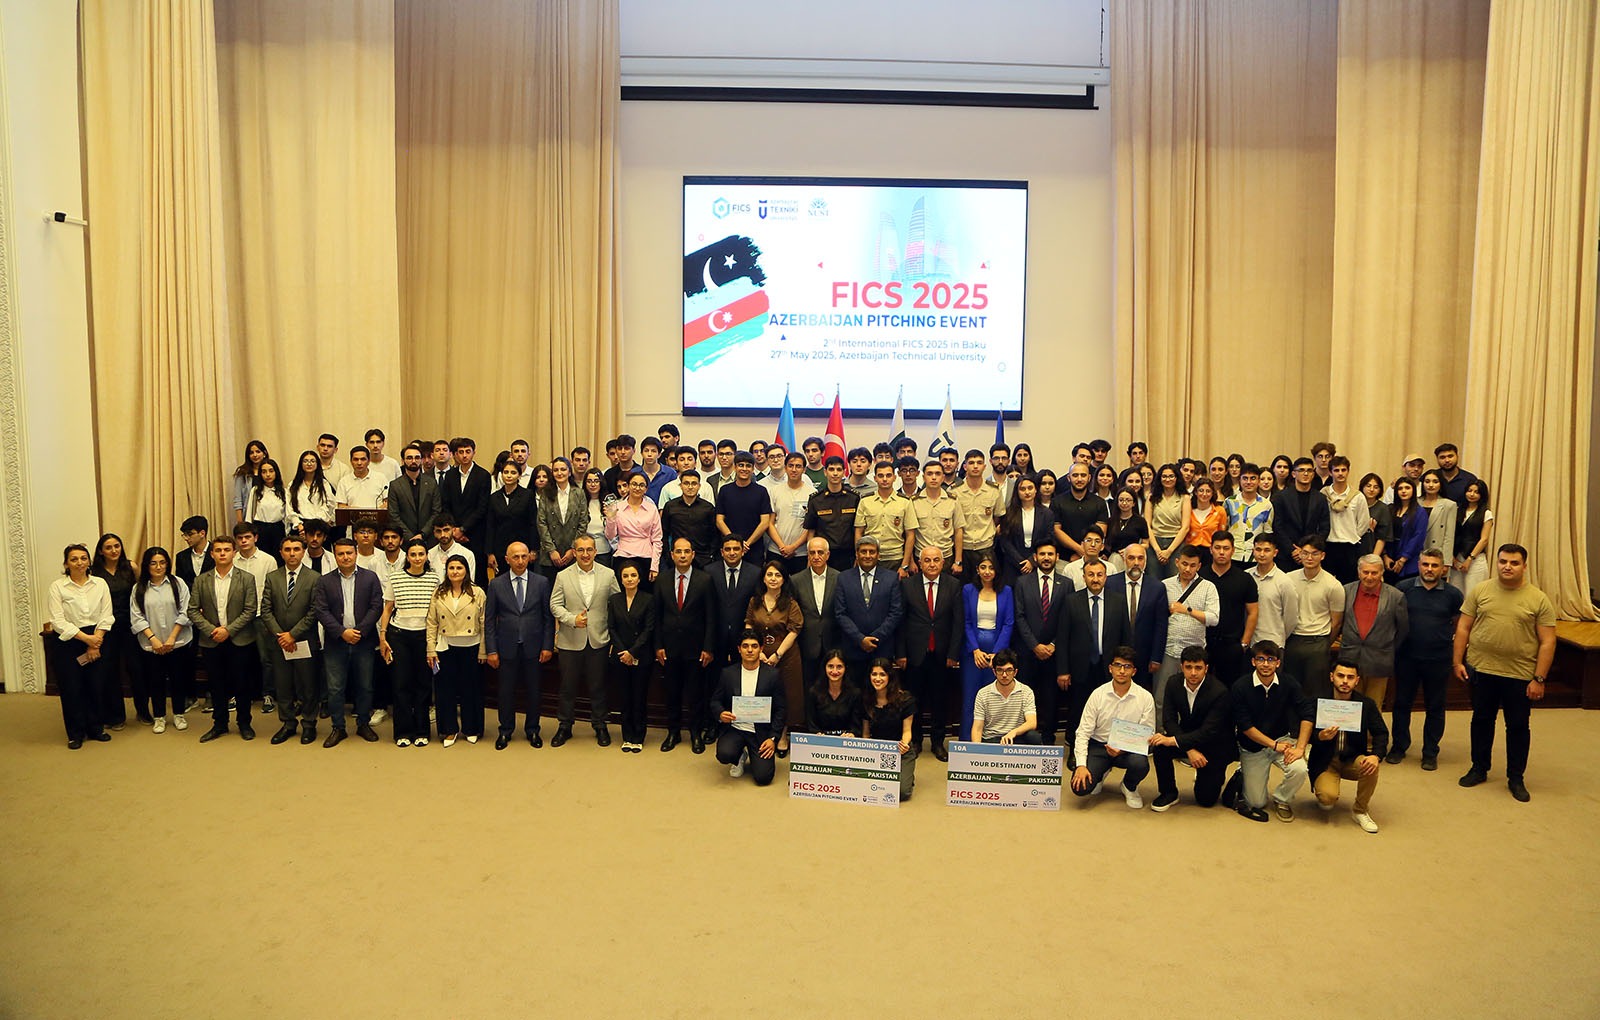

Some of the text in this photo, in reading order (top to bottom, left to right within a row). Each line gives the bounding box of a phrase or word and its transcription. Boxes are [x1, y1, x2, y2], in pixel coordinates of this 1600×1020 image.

[732, 204, 751, 212] FICS
[832, 281, 988, 310] FICS 2025
[769, 314, 988, 328] AZERBAIJAN PITCHING EVENT
[838, 339, 900, 348] International
[902, 340, 924, 348] FICS
[926, 340, 948, 349] 2025
[951, 340, 960, 349] in
[962, 340, 986, 350] Baku
[790, 351, 810, 361] May
[812, 351, 837, 360] 2025,
[839, 352, 890, 362] Azerbaijan
[892, 352, 937, 361] Technical
[940, 352, 986, 364] University
[842, 740, 898, 751] BOARDING PASS
[811, 752, 876, 764] YOUR DESTINATION
[792, 765, 832, 774] AZERBAIJAN
[990, 761, 1036, 770] DESTINATION
[868, 772, 898, 780] PAKISTAN
[950, 773, 992, 781] AZERBAIJAN
[793, 782, 841, 794] FICS 2025
[950, 790, 1000, 800] FICS 2025
